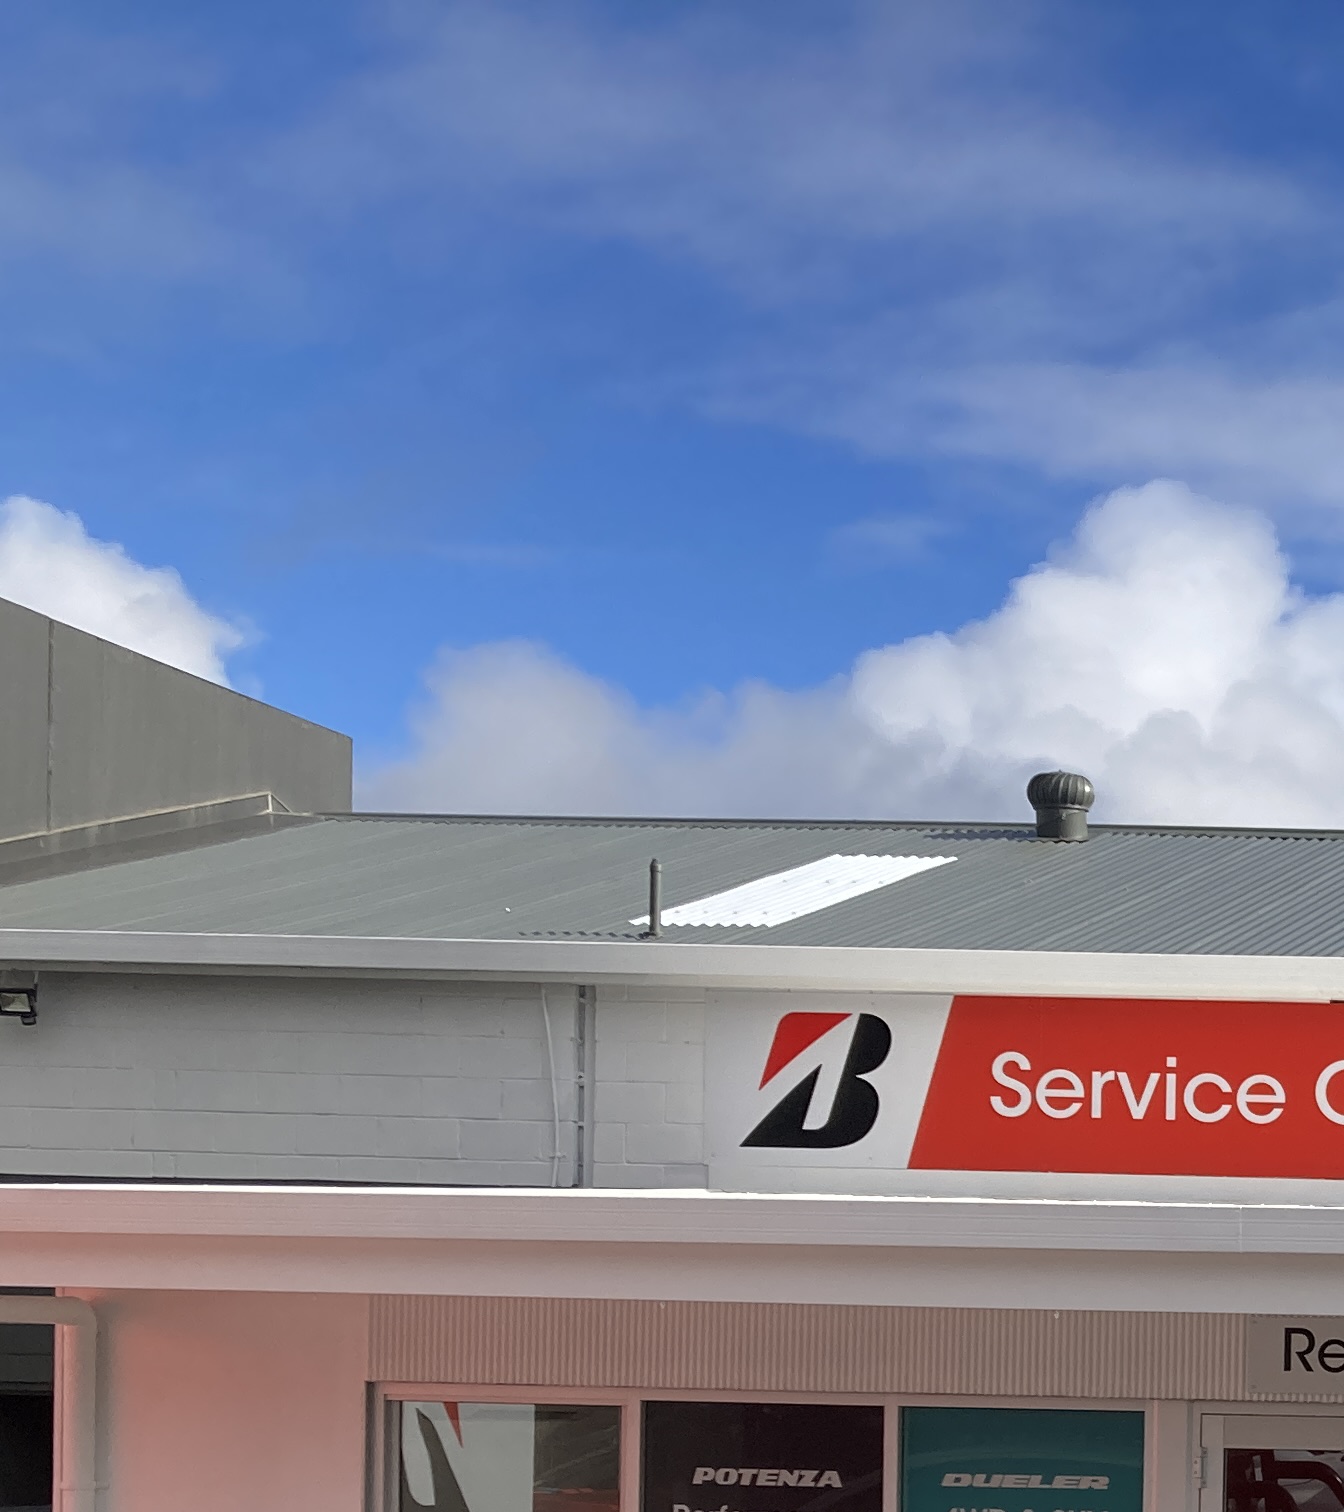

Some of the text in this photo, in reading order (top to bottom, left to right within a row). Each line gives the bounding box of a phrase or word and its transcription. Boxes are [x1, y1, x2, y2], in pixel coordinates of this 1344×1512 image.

[990, 1051, 1286, 1125] Service
[692, 1467, 843, 1488] POTENZA
[941, 1472, 1109, 1490] DUELER
